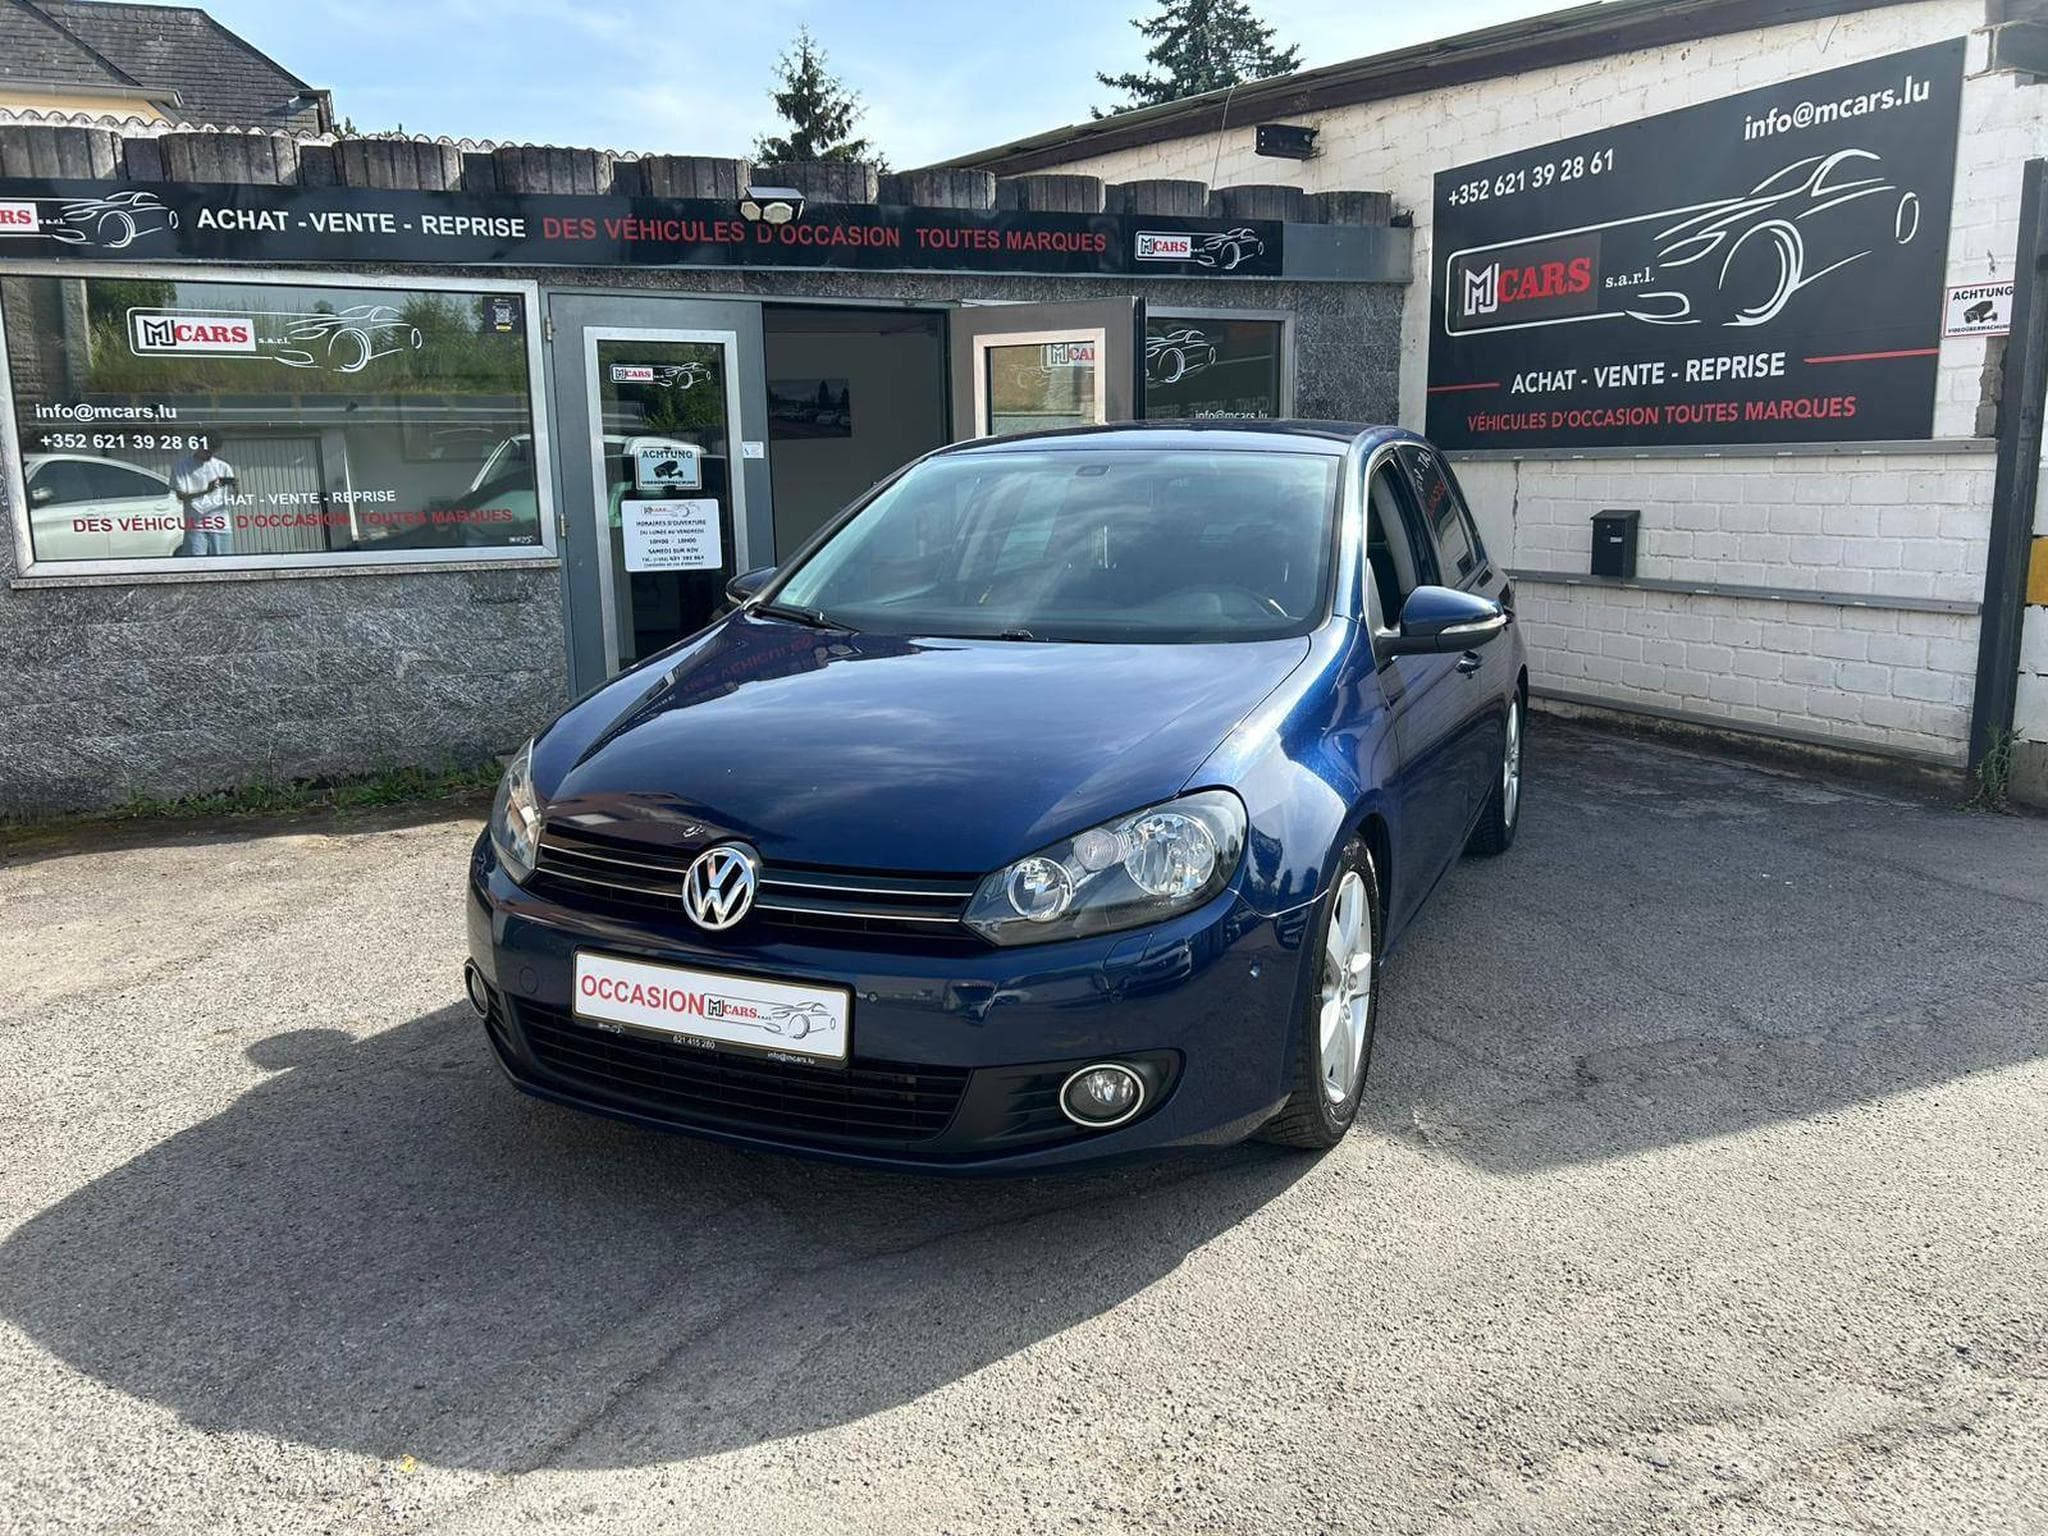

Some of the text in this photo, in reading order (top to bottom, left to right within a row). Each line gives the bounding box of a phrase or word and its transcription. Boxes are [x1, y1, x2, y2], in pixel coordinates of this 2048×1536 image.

[1744, 76, 1930, 141] info@mcars.lu
[1448, 148, 1615, 206] +352 621 39 28 61
[197, 208, 289, 231] ACHAT
[421, 215, 526, 238] REPRISE
[543, 217, 597, 240] DES
[604, 213, 746, 242] VÉHICULES
[757, 224, 900, 247] D'OCCASION
[916, 228, 1000, 250] TOUTES
[1006, 230, 1107, 251] MARQUES
[1605, 266, 1655, 289] s.a.r.l.
[1953, 286, 2013, 301] ACHTUNG
[1510, 368, 1577, 394] ACHAT
[1593, 361, 1665, 389] VENTE
[1685, 352, 1786, 383] REPRISE
[36, 404, 177, 422] info@mcars.lu
[1467, 409, 1546, 432] VÉHICULES
[1665, 403, 1738, 425] TOUTES
[1745, 396, 1857, 422] MARQUES
[40, 434, 209, 450] +352 621 39 28 61
[642, 450, 693, 459] ACHTUNG
[201, 494, 256, 506] ACHAT
[268, 493, 321, 506] VENTE
[333, 490, 397, 504] REPRISE
[73, 518, 113, 533] DES
[118, 514, 226, 532] VÉHICULES
[360, 511, 426, 526] TOUTES
[431, 508, 513, 525] MARQUES
[581, 975, 704, 1016] OCCASION
